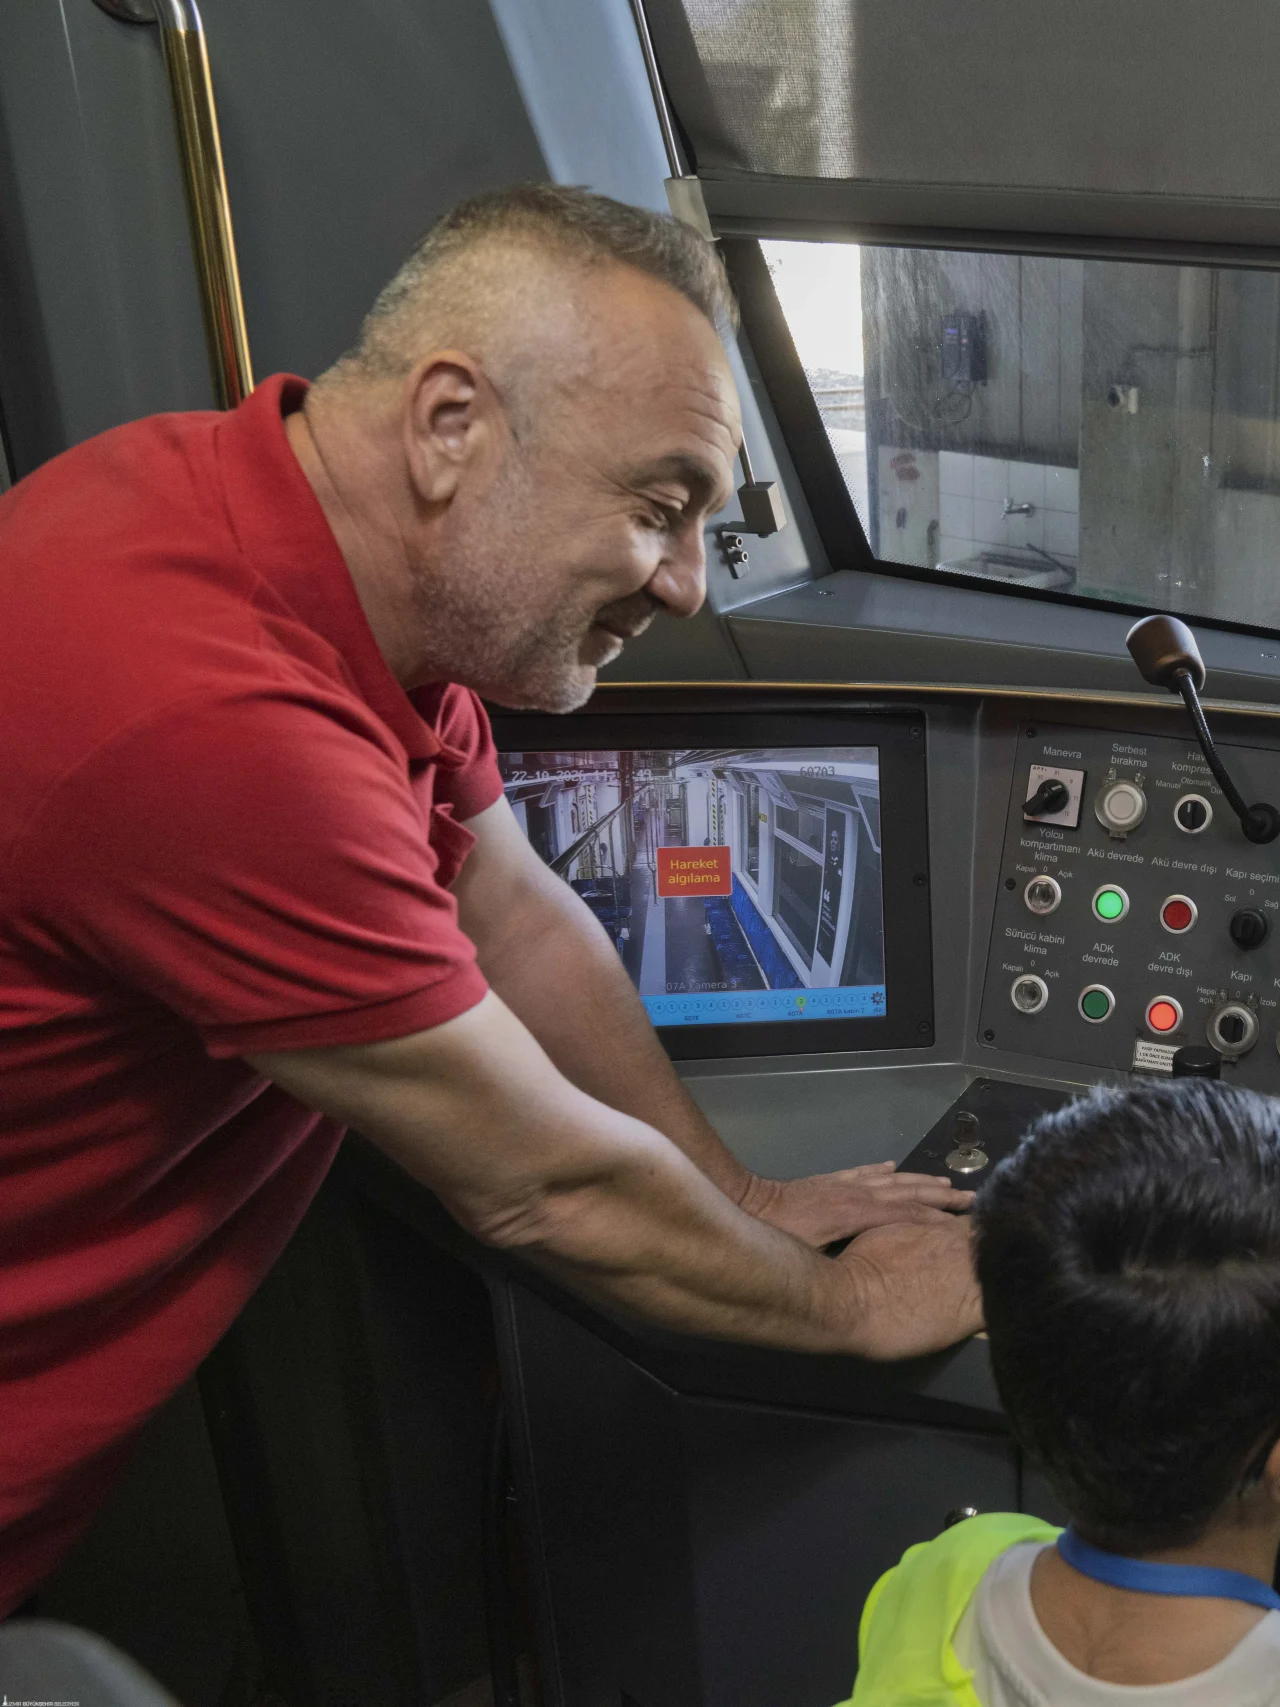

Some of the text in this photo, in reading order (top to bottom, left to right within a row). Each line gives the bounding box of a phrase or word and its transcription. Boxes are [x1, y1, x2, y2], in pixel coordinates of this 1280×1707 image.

[1043, 745, 1082, 759] Manevra
[1111, 743, 1148, 756] Serbest
[1111, 756, 1148, 768] bırakma
[1187, 751, 1207, 762] Hav
[800, 766, 835, 778] 607A3
[1171, 761, 1215, 775] kompres
[1156, 779, 1182, 790] Manuel
[1180, 776, 1212, 787] Otomatik
[1039, 828, 1064, 840] Yolcu
[1020, 839, 1081, 854] kompartımanı
[1034, 852, 1058, 863] klima
[1087, 848, 1144, 864] Akü devrede
[670, 858, 719, 870] Hareket
[1016, 864, 1037, 874] Kapalı
[1152, 856, 1217, 874] Akü devre dışı
[668, 872, 721, 886] algılama
[1058, 870, 1074, 878] Açık
[1225, 868, 1280, 884] Kapı seçimi
[1224, 894, 1236, 902] Sol
[1264, 900, 1279, 910] Sağ
[1004, 927, 1066, 944] Sürücü kabini
[1023, 944, 1048, 955] klima
[1092, 942, 1115, 954] ADK
[1082, 954, 1120, 967] devrede
[1158, 952, 1181, 962] ADK
[1002, 962, 1024, 973] Kapalı
[1044, 968, 1060, 978] Açık
[1148, 962, 1193, 978] devre dışı
[1230, 970, 1252, 982] Kapı
